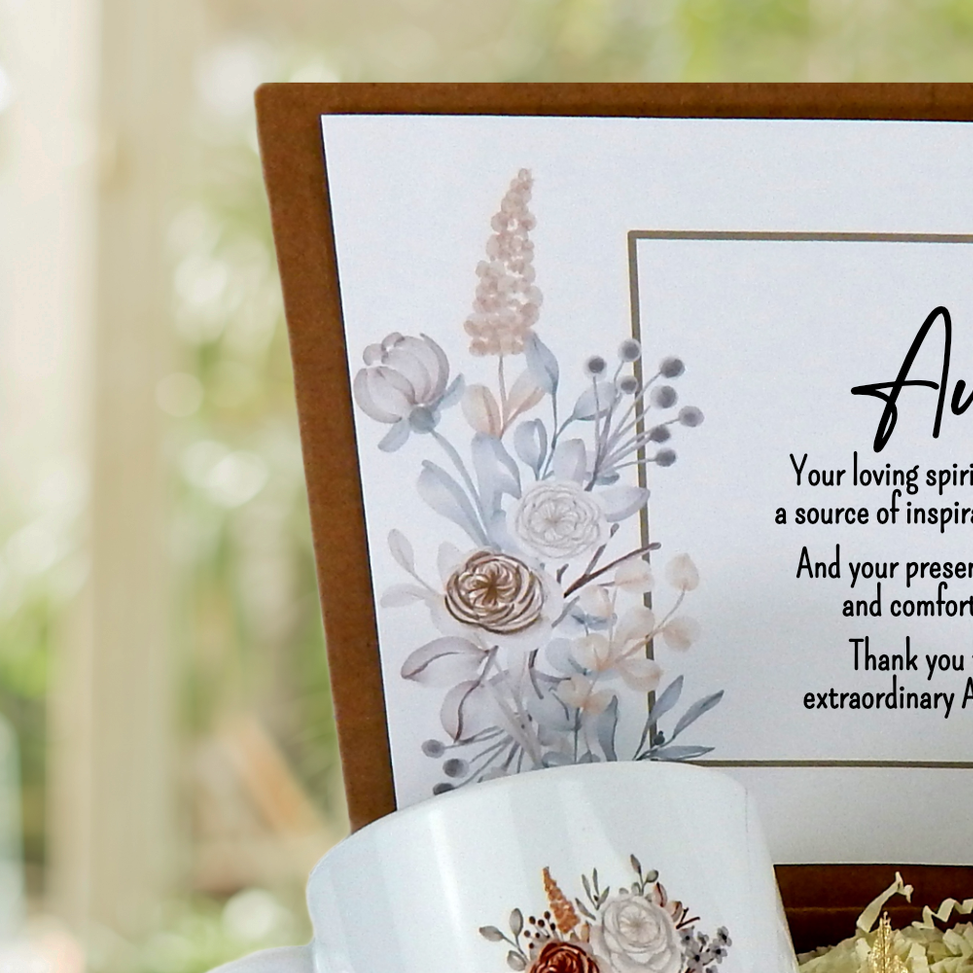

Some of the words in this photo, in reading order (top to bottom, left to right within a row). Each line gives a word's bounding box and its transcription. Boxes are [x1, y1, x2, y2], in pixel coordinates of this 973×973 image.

[790, 454, 846, 486] Your
[854, 451, 919, 495] loving
[775, 508, 786, 524] a
[795, 508, 869, 524] source
[877, 489, 902, 524] of
[796, 544, 840, 578] And
[849, 562, 899, 588] your
[843, 582, 881, 617] and
[849, 636, 918, 671] Thank
[926, 654, 964, 680] you
[804, 674, 954, 719] extraordinary
